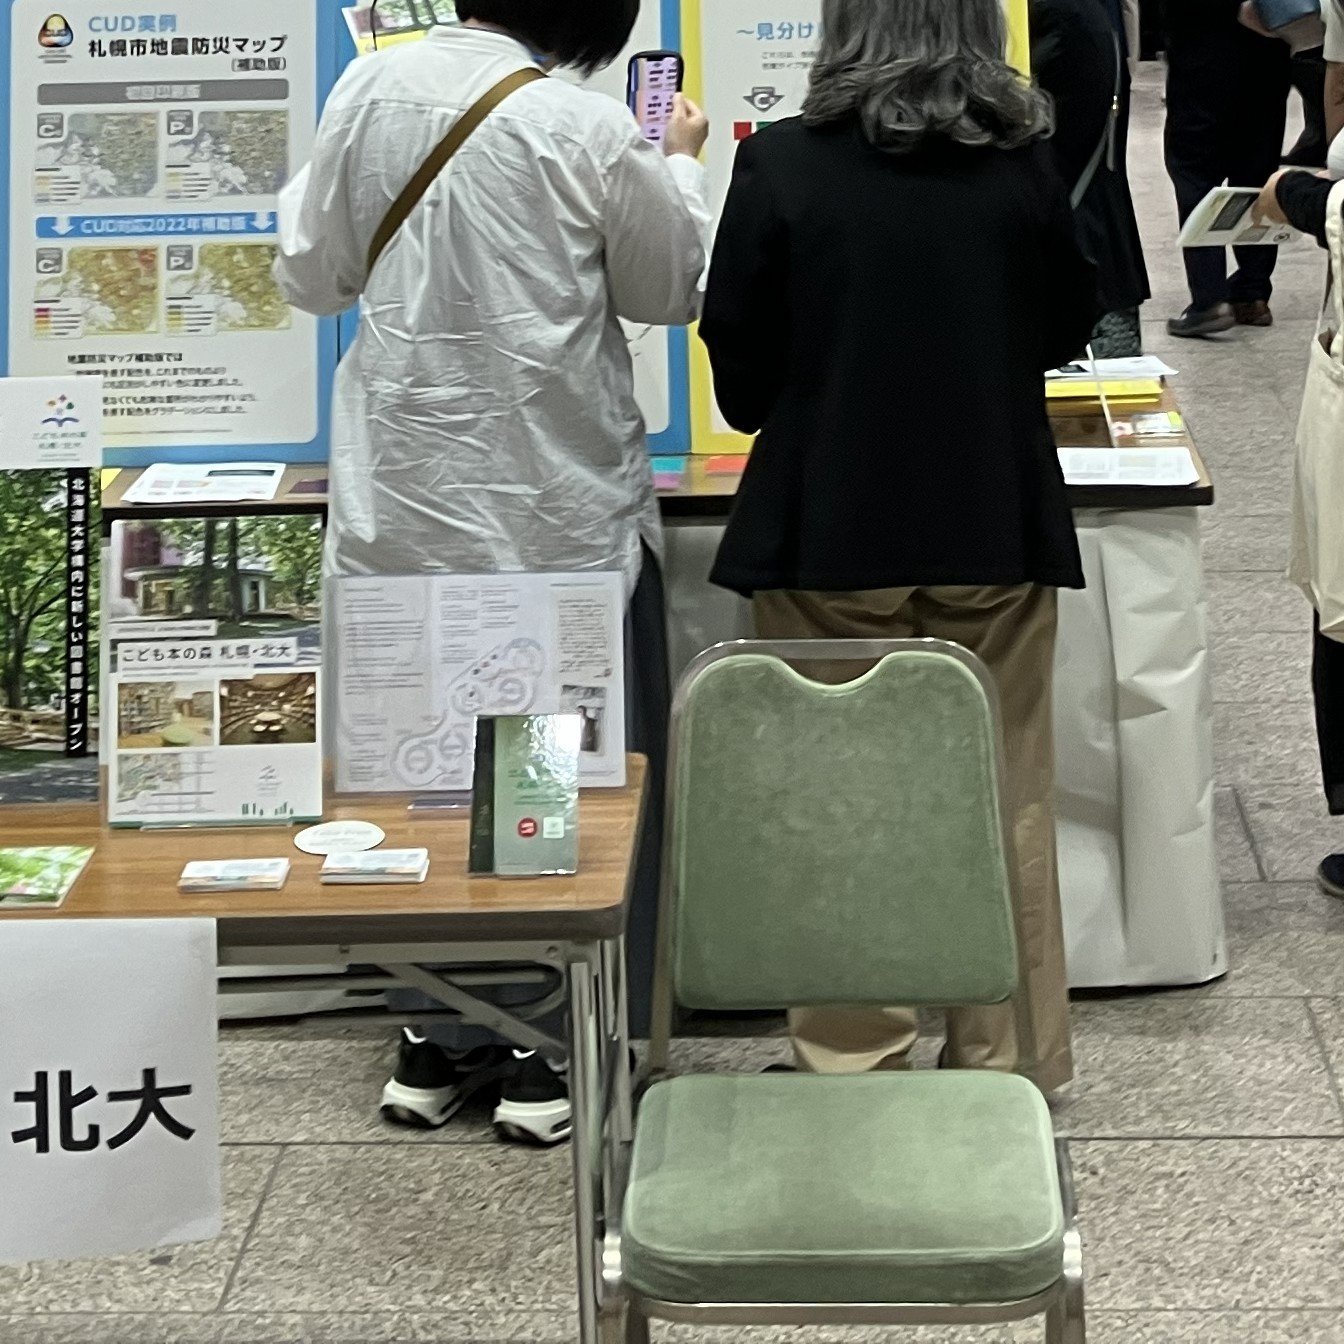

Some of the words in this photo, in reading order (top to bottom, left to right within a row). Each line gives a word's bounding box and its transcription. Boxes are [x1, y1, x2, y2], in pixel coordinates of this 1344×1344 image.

[88, 14, 177, 32] CUD実例
[736, 22, 821, 41] ～見分け
[88, 35, 289, 58] 札幌市地震防災マップ
[122, 646, 212, 663] こども本の森
[219, 643, 292, 660] 札幌・北大
